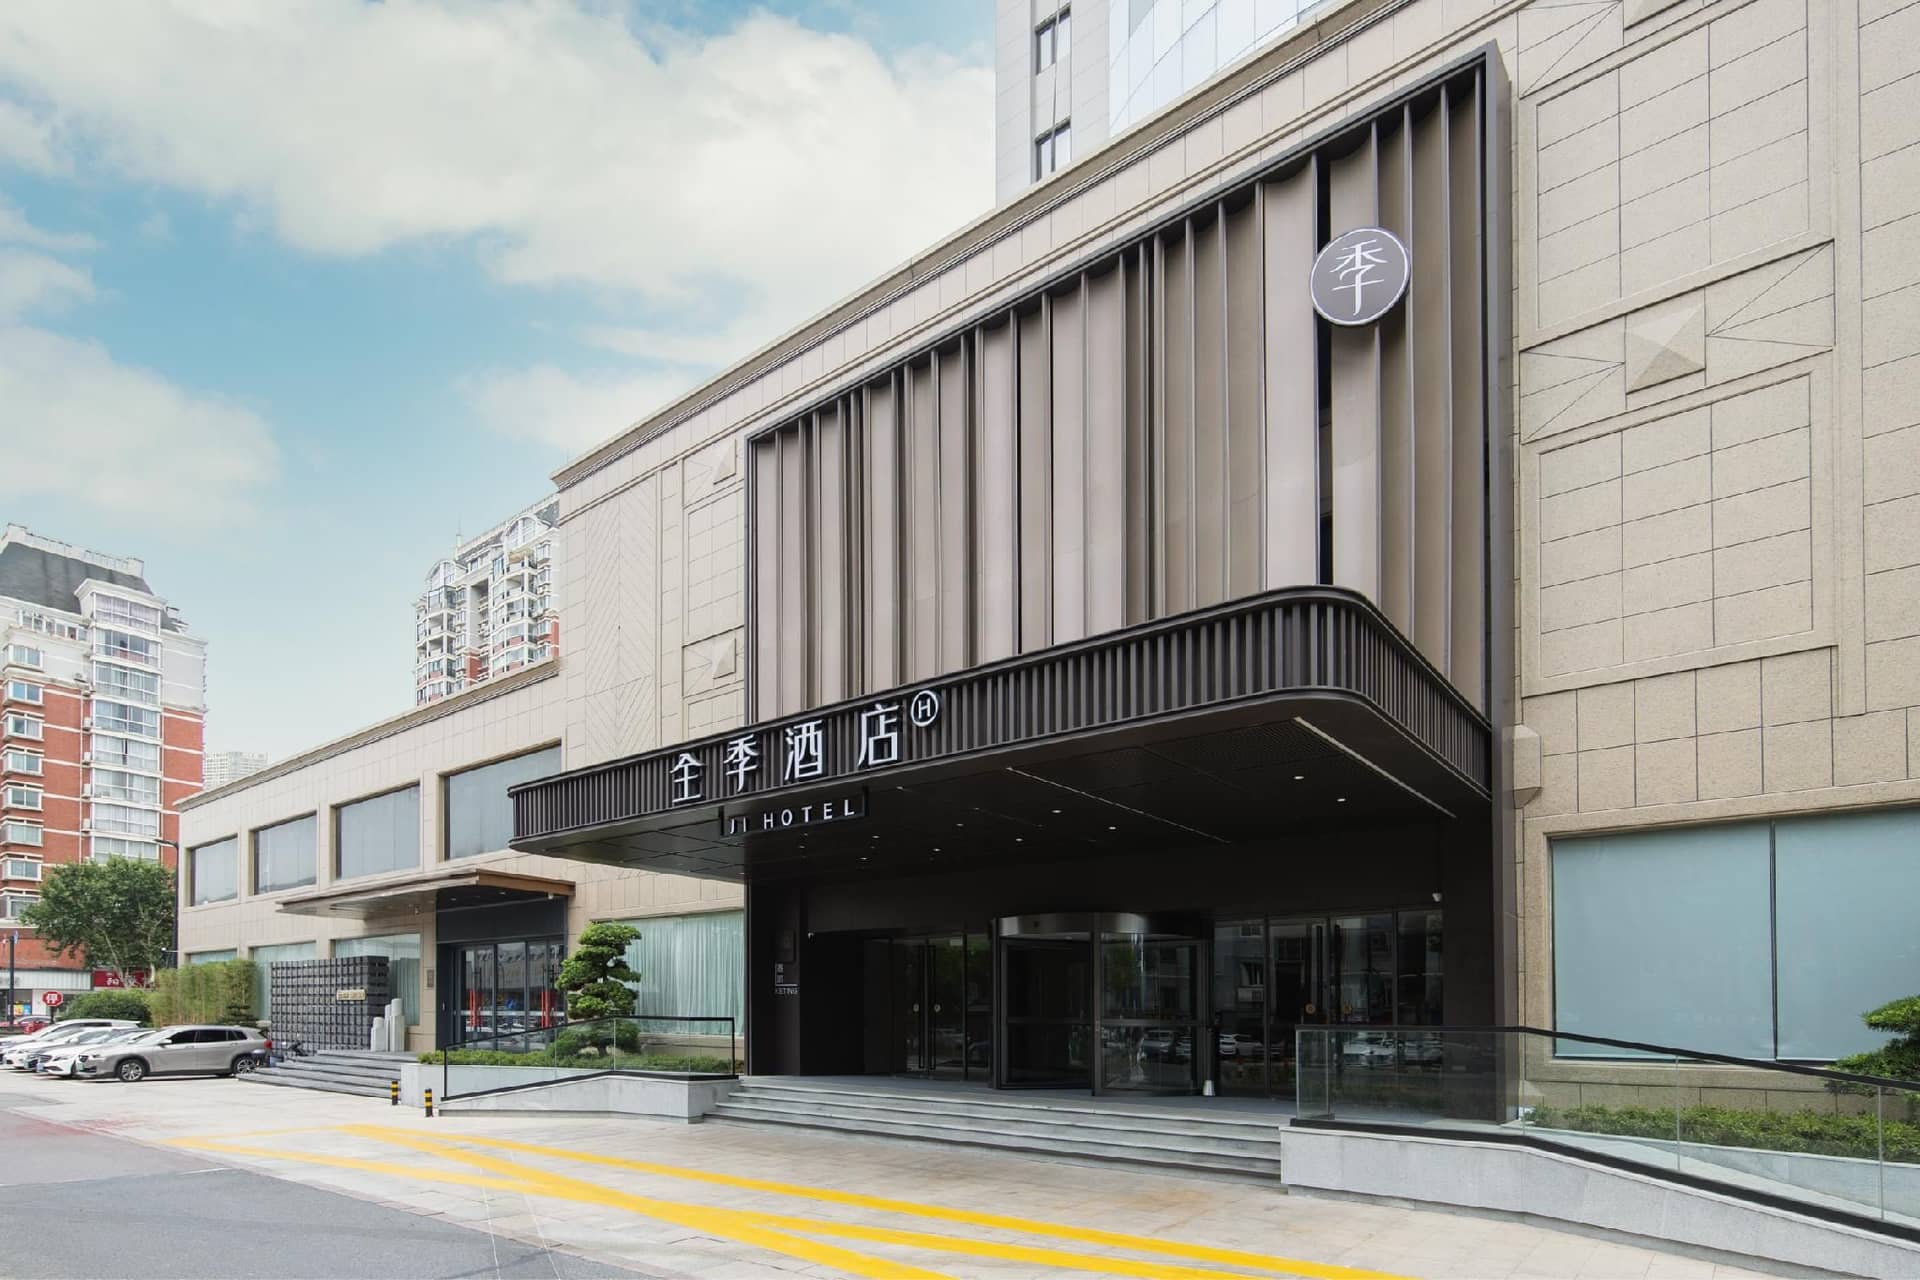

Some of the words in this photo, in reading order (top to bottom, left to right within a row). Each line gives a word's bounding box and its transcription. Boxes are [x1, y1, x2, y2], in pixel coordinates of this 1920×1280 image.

[1329, 239, 1389, 316] 季
[670, 703, 900, 805] 全季酒店
[729, 816, 747, 835] JI
[763, 799, 855, 830] HOTEL
